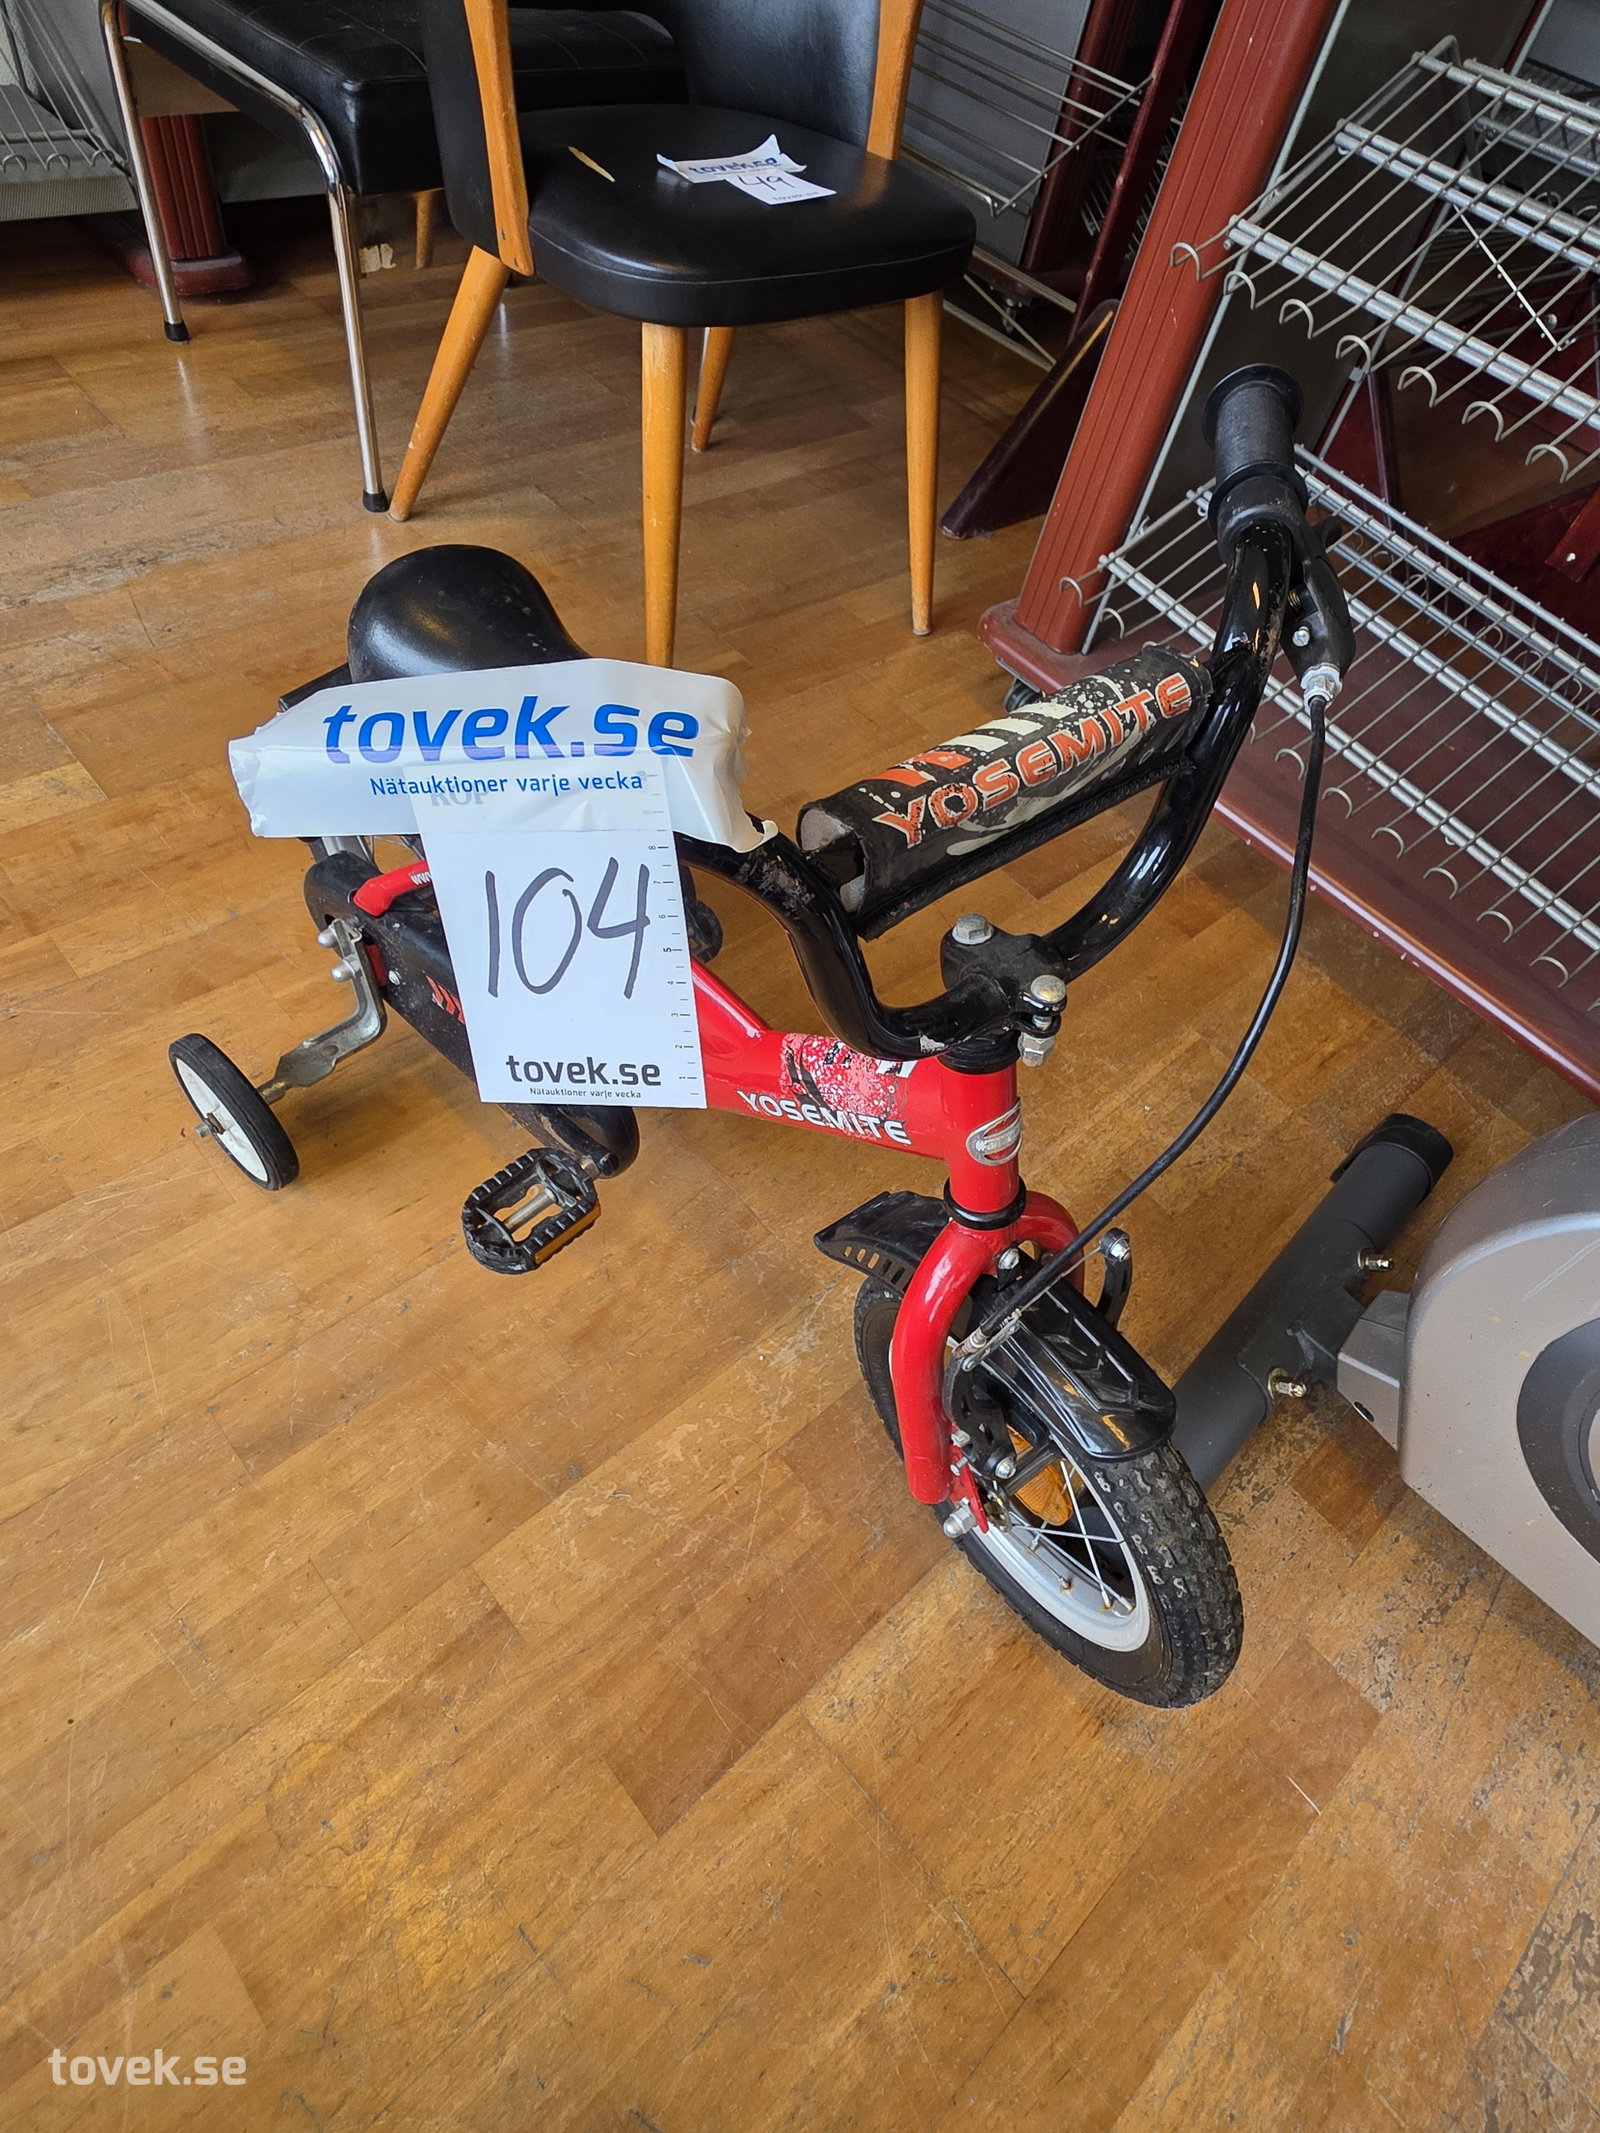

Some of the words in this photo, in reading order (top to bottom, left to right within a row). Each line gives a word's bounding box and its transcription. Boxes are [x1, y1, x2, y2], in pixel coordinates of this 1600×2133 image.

[738, 174, 795, 191] 49
[323, 695, 700, 764] tovek.se
[871, 671, 1192, 848] YOSEMITE
[370, 775, 508, 796] Nätauktioner
[516, 773, 571, 797] varje
[578, 770, 643, 790] vecka
[485, 856, 651, 1000] 104
[506, 1055, 661, 1086] tovek.se
[590, 1089, 613, 1099] varje
[615, 1089, 642, 1099] vecka
[736, 1089, 912, 1145] YOSEMITE
